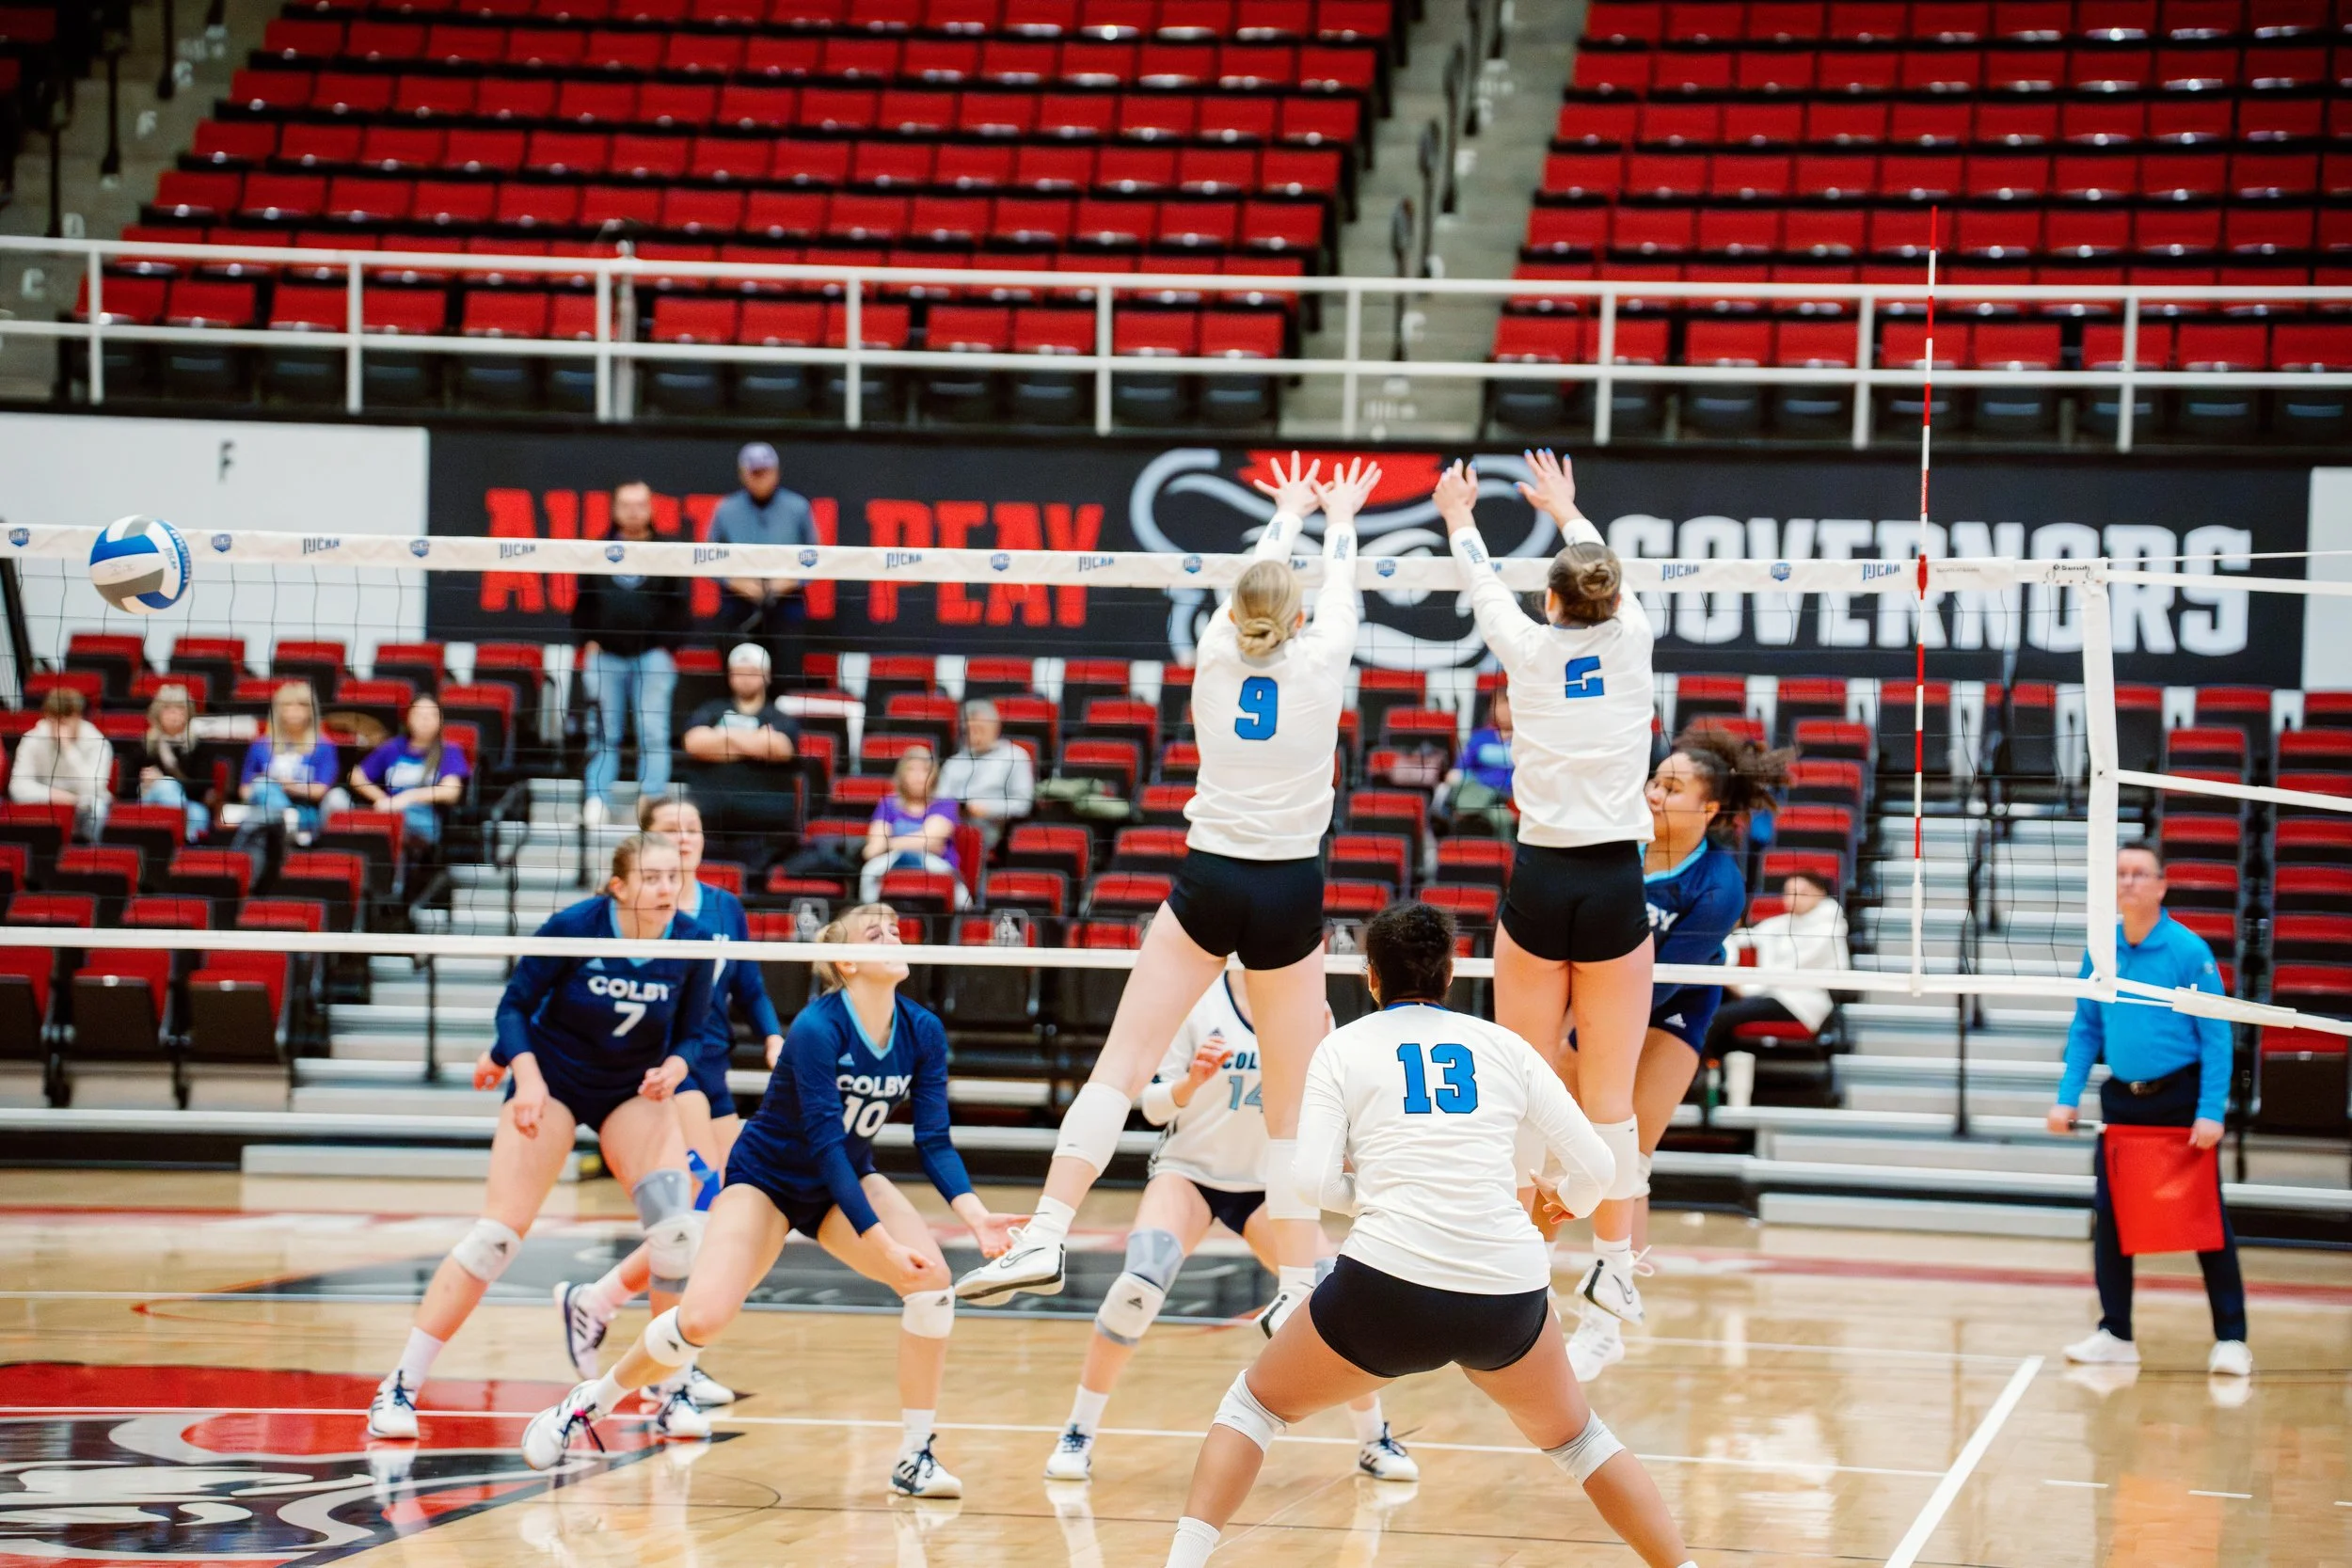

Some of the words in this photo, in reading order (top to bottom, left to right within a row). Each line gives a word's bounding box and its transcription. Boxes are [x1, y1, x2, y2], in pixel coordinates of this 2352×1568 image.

[865, 499, 1105, 628] PEAY
[1565, 656, 1605, 698] 5
[1234, 676, 1278, 740] 9
[612, 1001, 647, 1037] 7
[835, 1073, 914, 1099] COLBY
[1396, 1043, 1478, 1114] 13
[842, 1095, 889, 1138] 10
